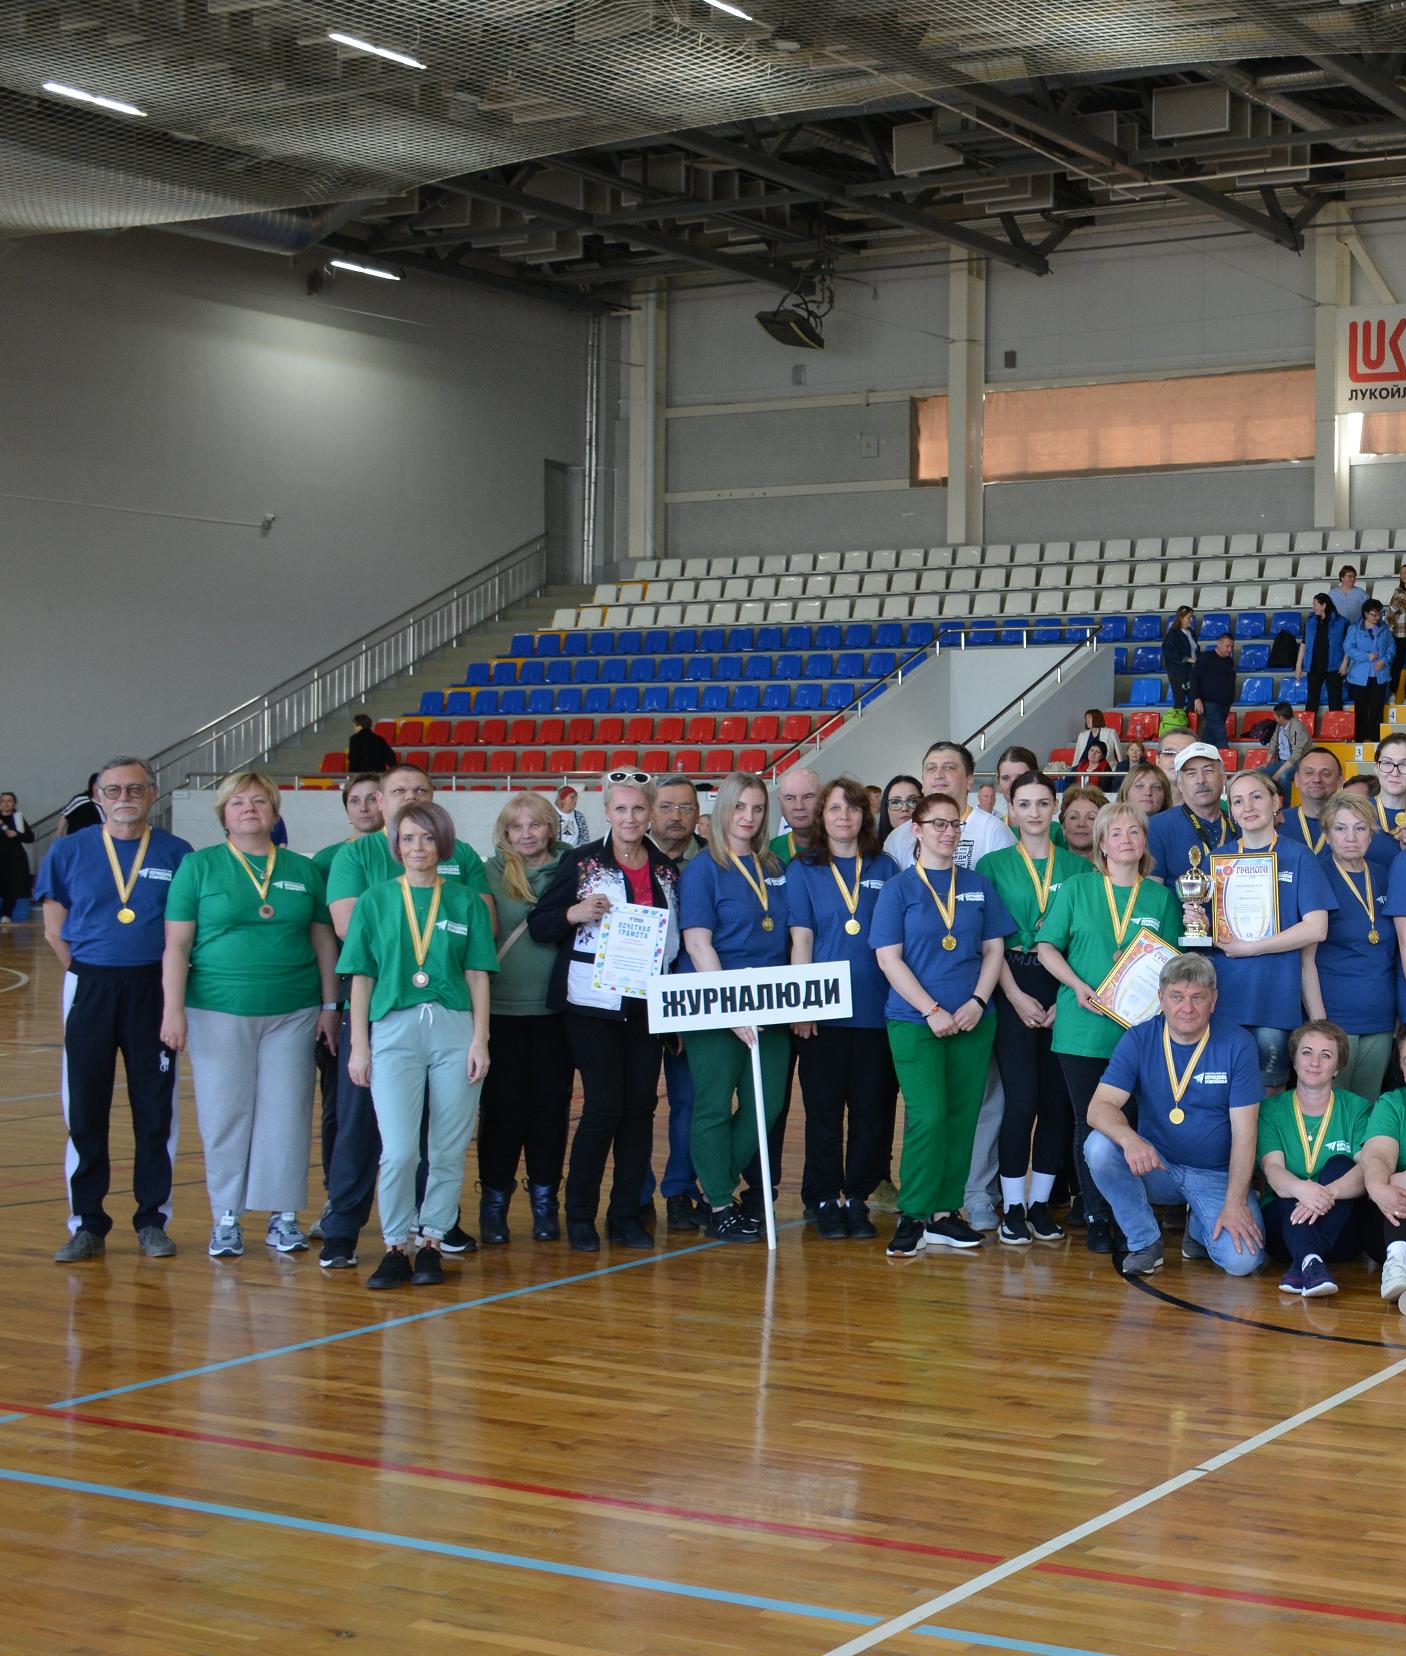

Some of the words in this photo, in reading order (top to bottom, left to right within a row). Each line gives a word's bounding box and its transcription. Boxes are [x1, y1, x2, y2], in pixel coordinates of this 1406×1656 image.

[1236, 865, 1269, 874] ГРАМОТА
[618, 921, 651, 932] ПОЧЕТНАЯ
[618, 928, 649, 939] ГРАМОТА
[661, 978, 841, 1018] ЖУРНАЛЮДИ
